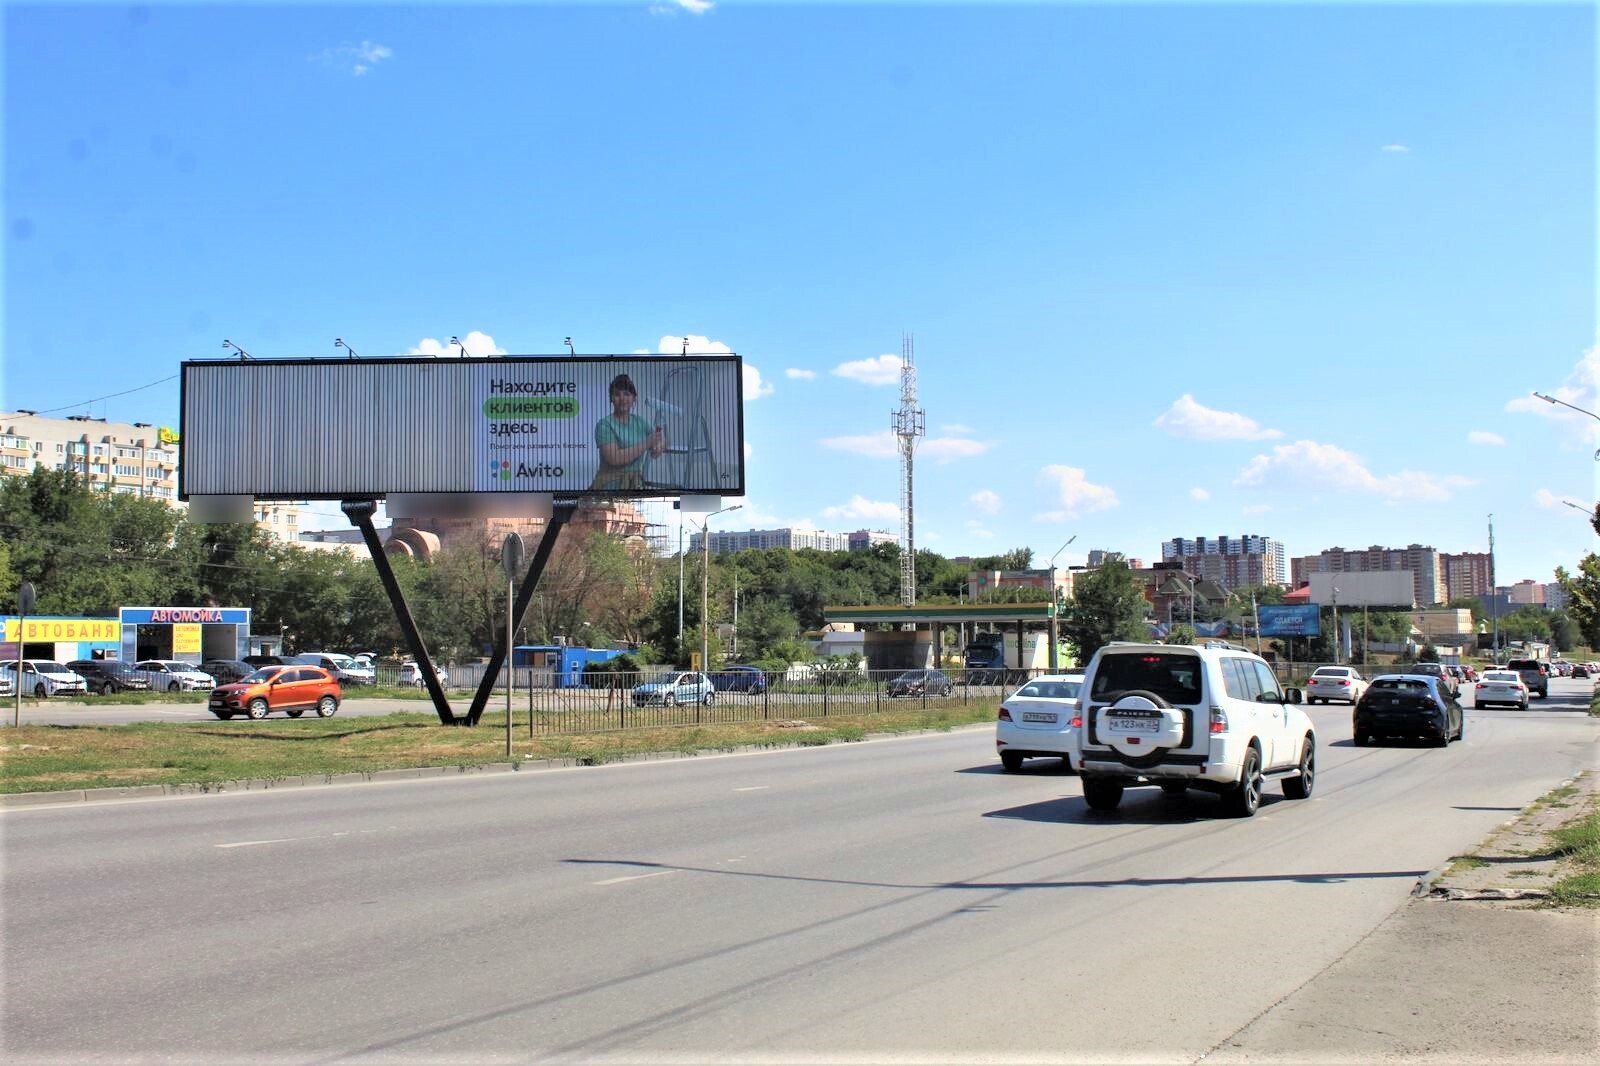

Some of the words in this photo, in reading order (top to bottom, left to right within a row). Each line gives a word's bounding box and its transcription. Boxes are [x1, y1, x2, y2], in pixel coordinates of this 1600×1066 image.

[490, 379, 577, 396] Находите
[490, 402, 574, 414] клиентов
[489, 423, 538, 437] здесь
[516, 462, 563, 478] Avito
[151, 609, 223, 622] АВТОМОЙКА
[13, 623, 114, 638] АВТОБАНЯ
